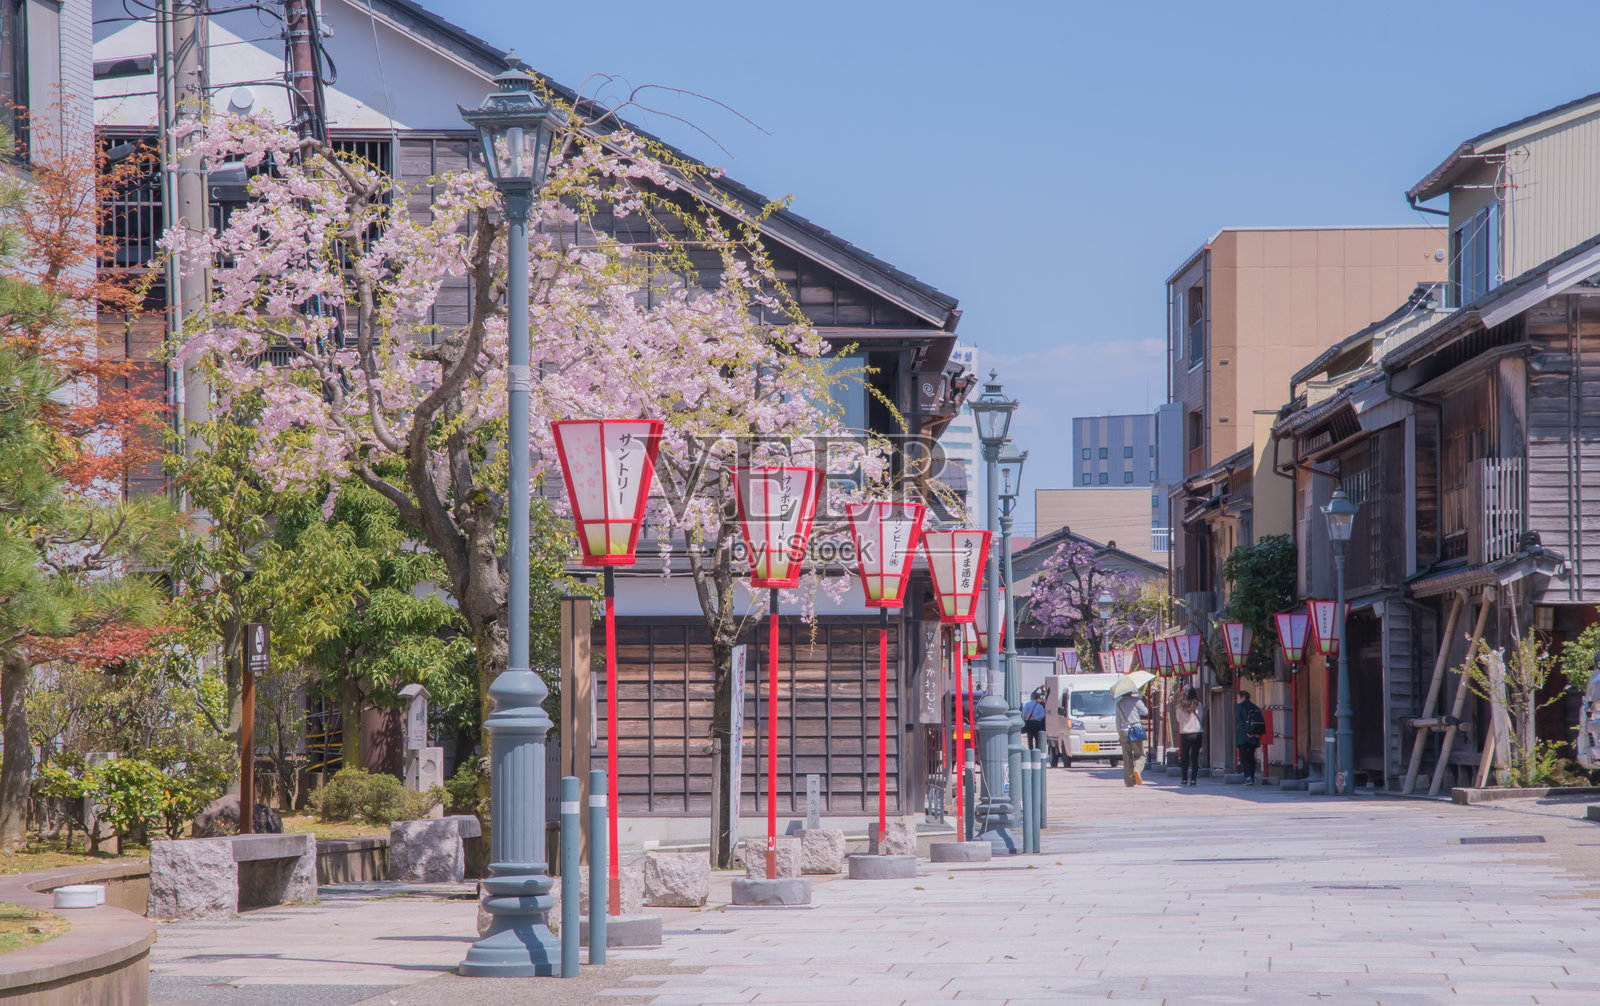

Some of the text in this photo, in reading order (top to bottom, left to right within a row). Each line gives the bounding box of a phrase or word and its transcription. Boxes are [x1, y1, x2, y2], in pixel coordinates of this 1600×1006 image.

[617, 432, 632, 505] サントリー
[777, 474, 793, 541] サッポロビール
